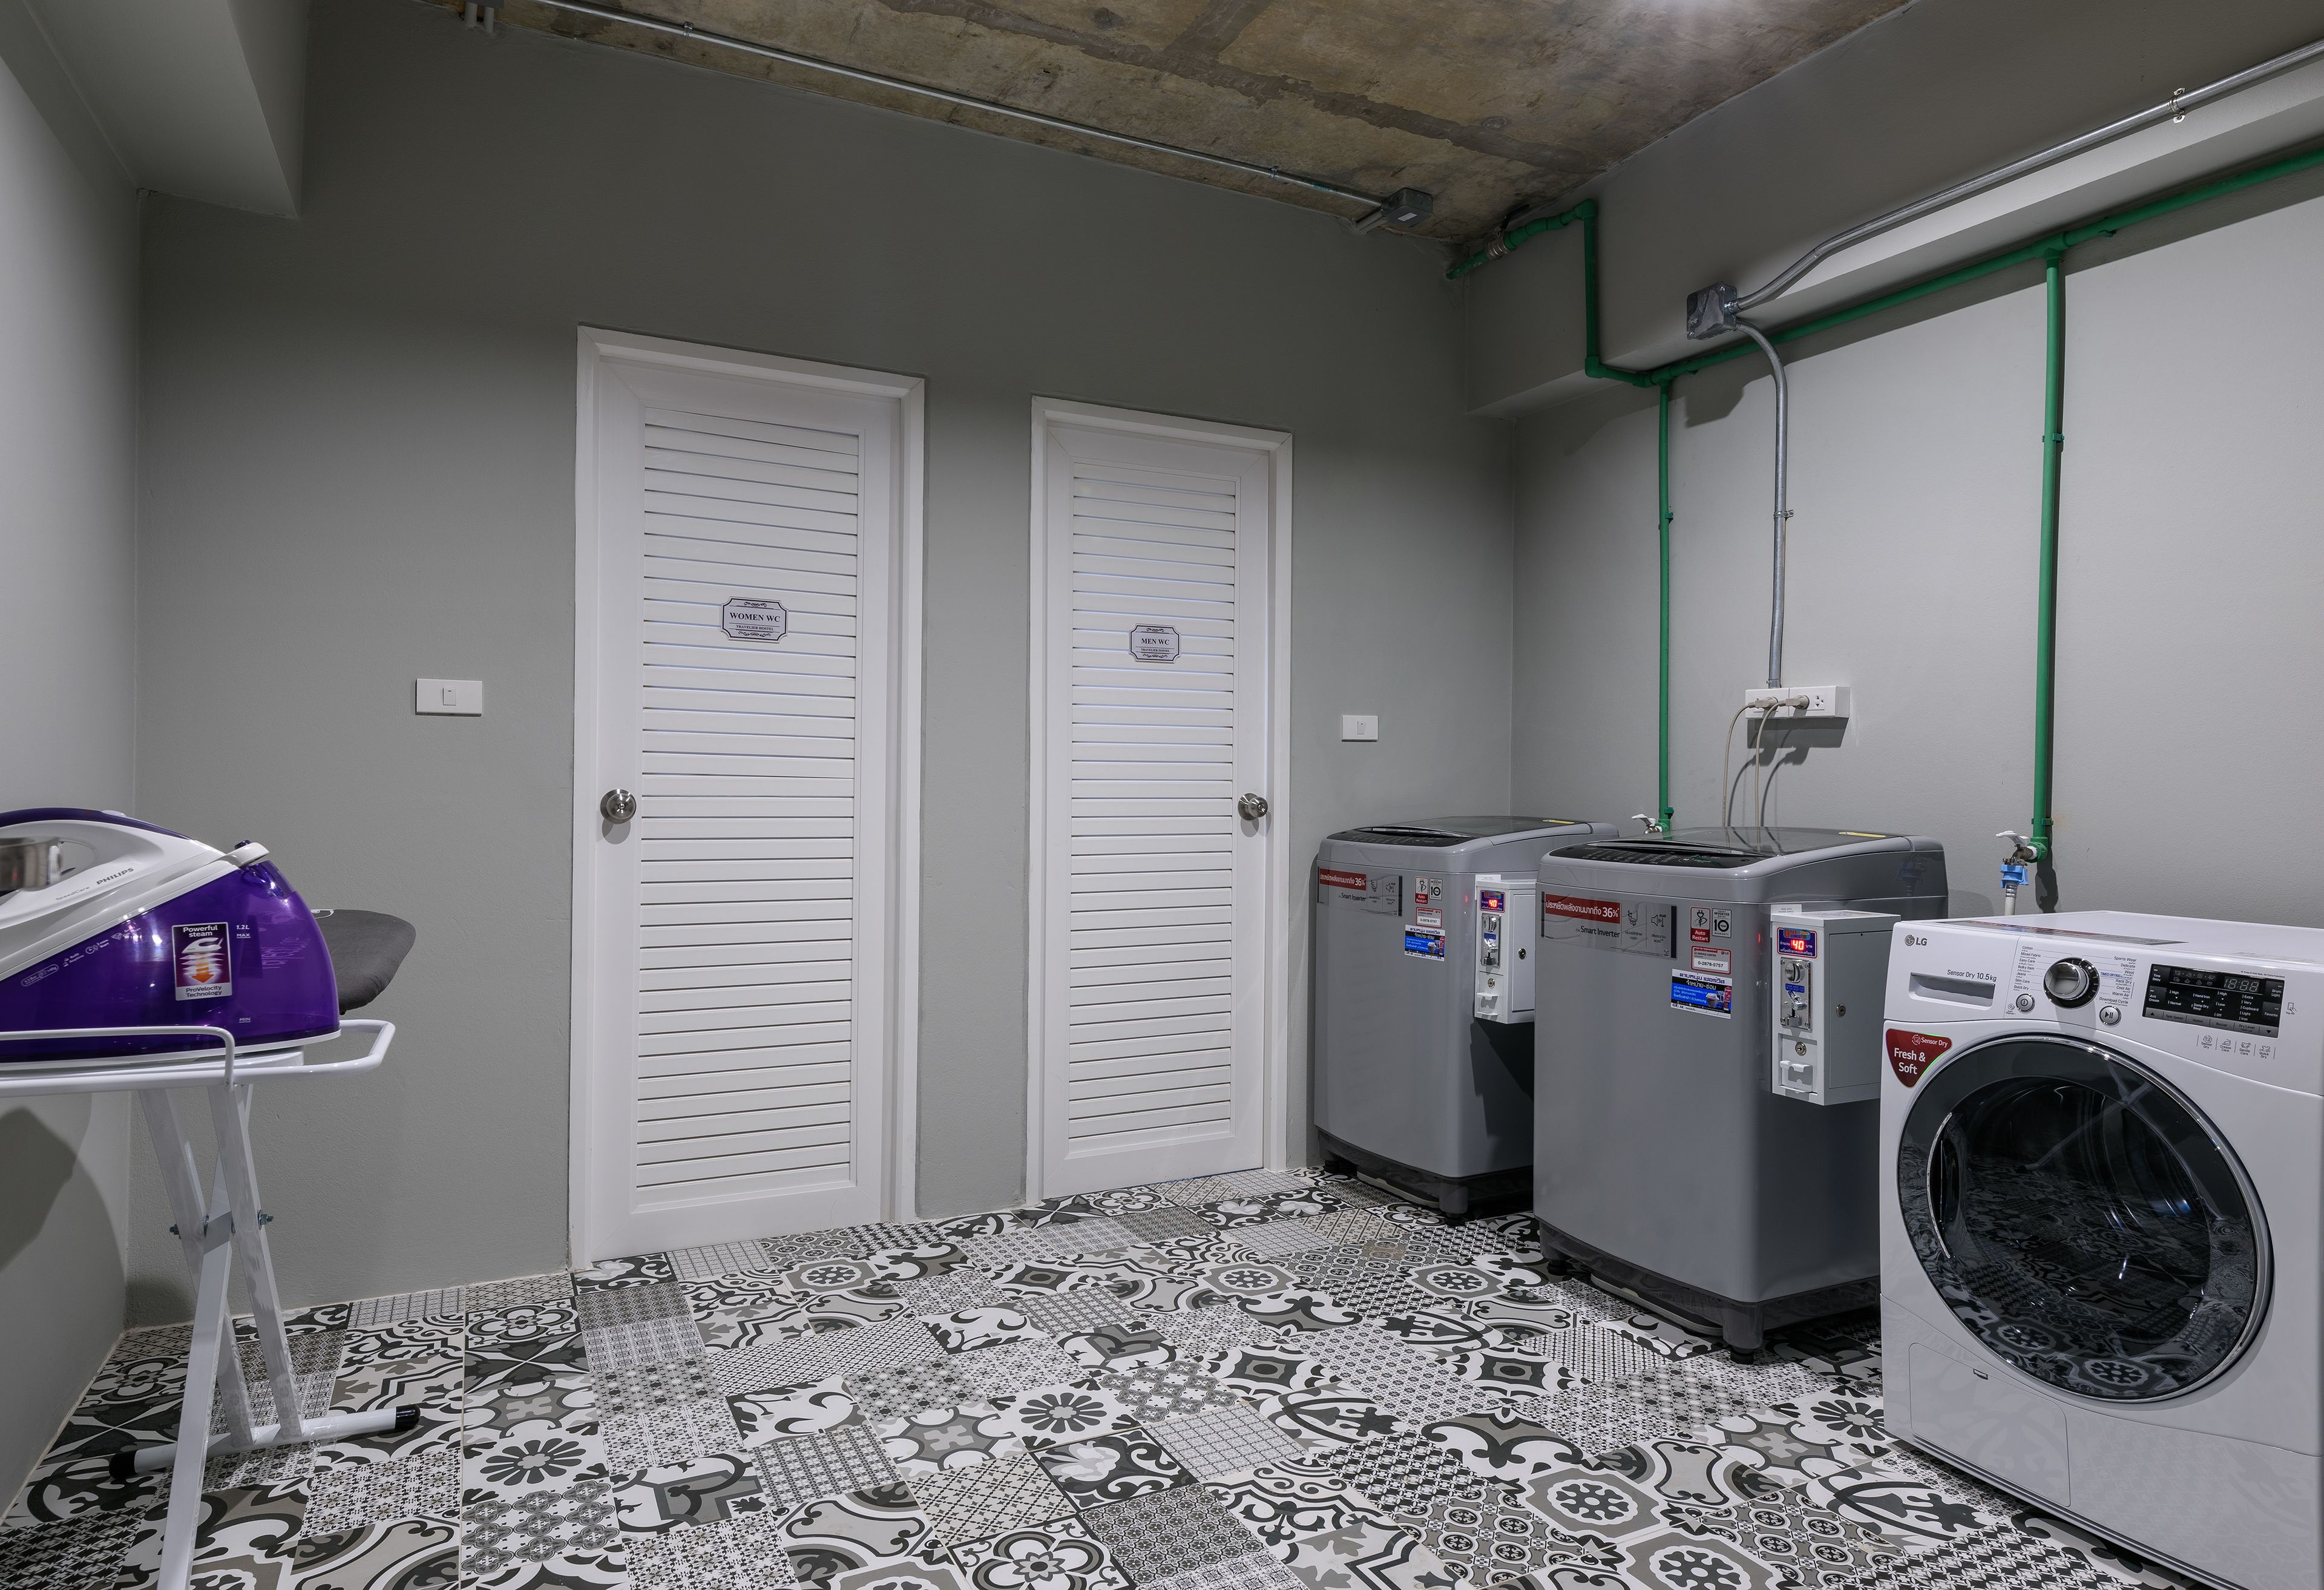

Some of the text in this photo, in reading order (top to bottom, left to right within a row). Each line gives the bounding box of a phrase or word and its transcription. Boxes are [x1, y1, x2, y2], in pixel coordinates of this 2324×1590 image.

[730, 612, 764, 621] WOMEN
[96, 867, 134, 884] PHILIPS
[1431, 886, 1440, 896] 10
[1581, 925, 1620, 938] Smart Inverter
[1714, 919, 1729, 932] 10
[1793, 940, 1804, 950] 40
[1915, 937, 1928, 946] LG
[1894, 1048, 1925, 1062] Fresh &
[1899, 1062, 1917, 1074] Soft
